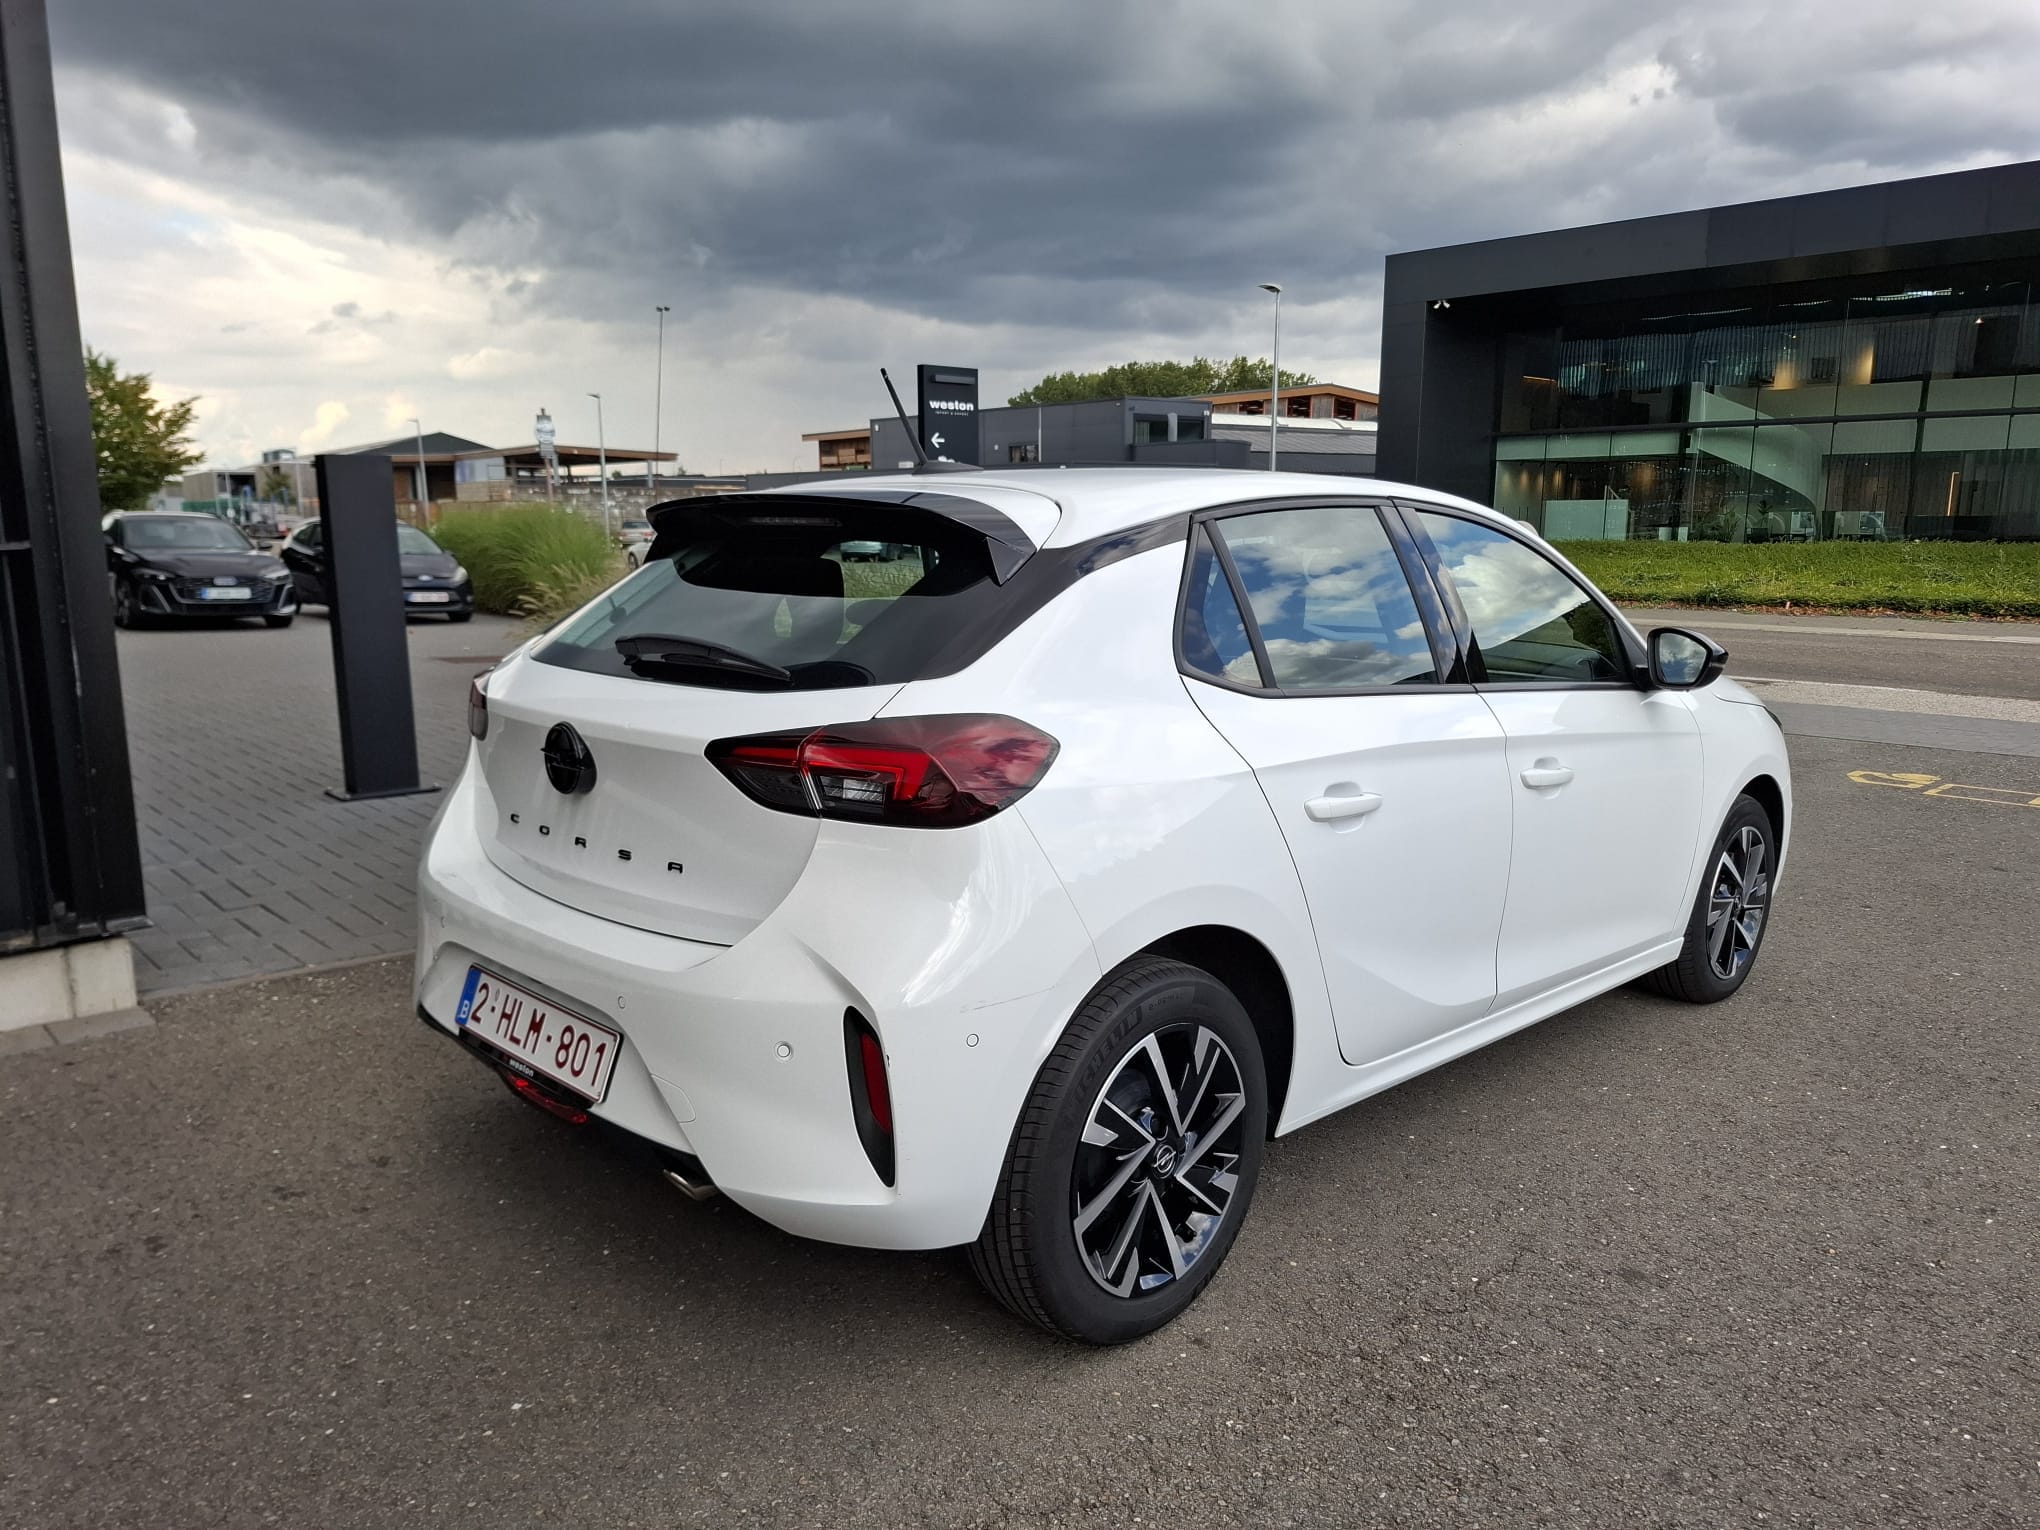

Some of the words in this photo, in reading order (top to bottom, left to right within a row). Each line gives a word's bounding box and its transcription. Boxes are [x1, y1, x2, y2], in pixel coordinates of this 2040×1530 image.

[929, 400, 974, 411] weston
[510, 813, 684, 873] CORSA
[460, 1000, 469, 1018] B
